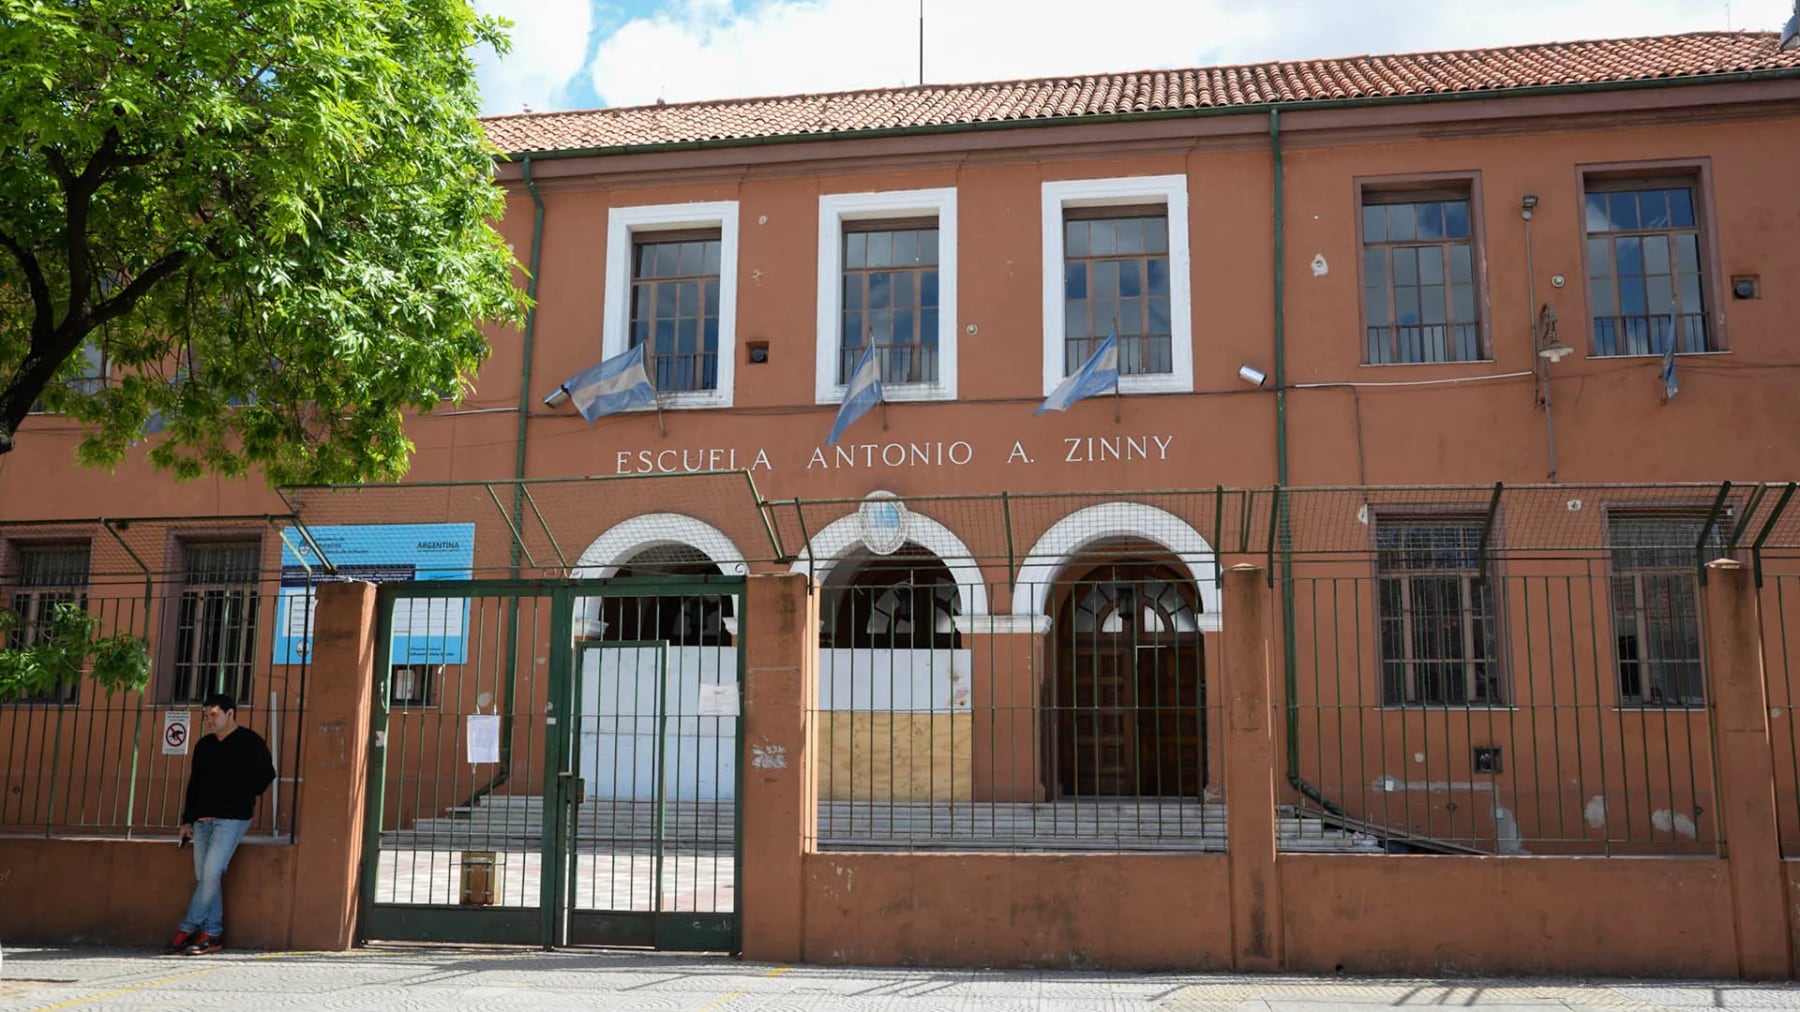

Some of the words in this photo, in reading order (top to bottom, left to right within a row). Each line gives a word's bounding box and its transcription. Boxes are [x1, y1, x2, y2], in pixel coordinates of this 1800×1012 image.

[616, 448, 773, 474] ESCUELA
[807, 440, 973, 469] ANTONIO
[1006, 440, 1035, 464] A.
[1064, 435, 1173, 462] ZINNY
[416, 540, 460, 550] ARGENTINA
